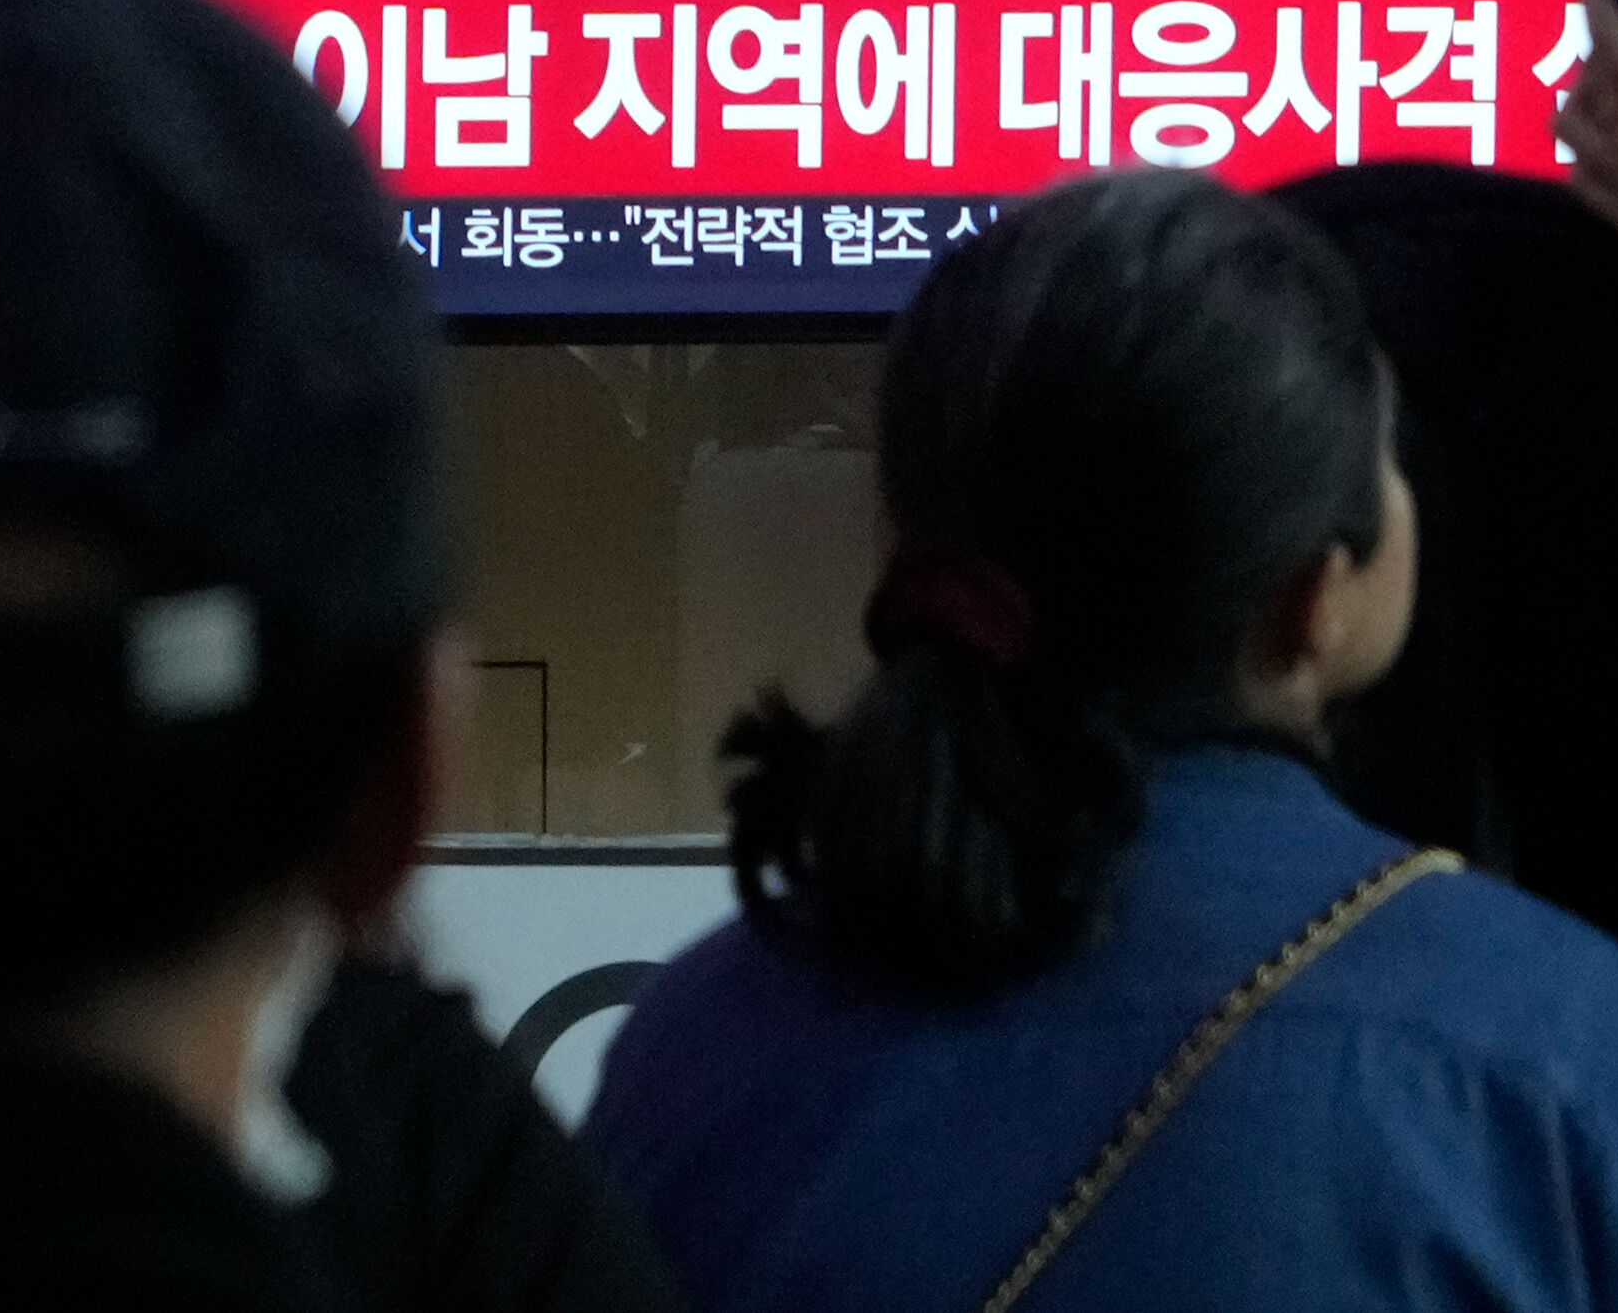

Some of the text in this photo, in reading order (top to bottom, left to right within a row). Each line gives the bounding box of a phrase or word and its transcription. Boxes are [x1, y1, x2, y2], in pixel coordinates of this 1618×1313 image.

[573, 3, 958, 170] 지역에
[999, 1, 1500, 170] 대응사격
[822, 204, 933, 266] 협조
